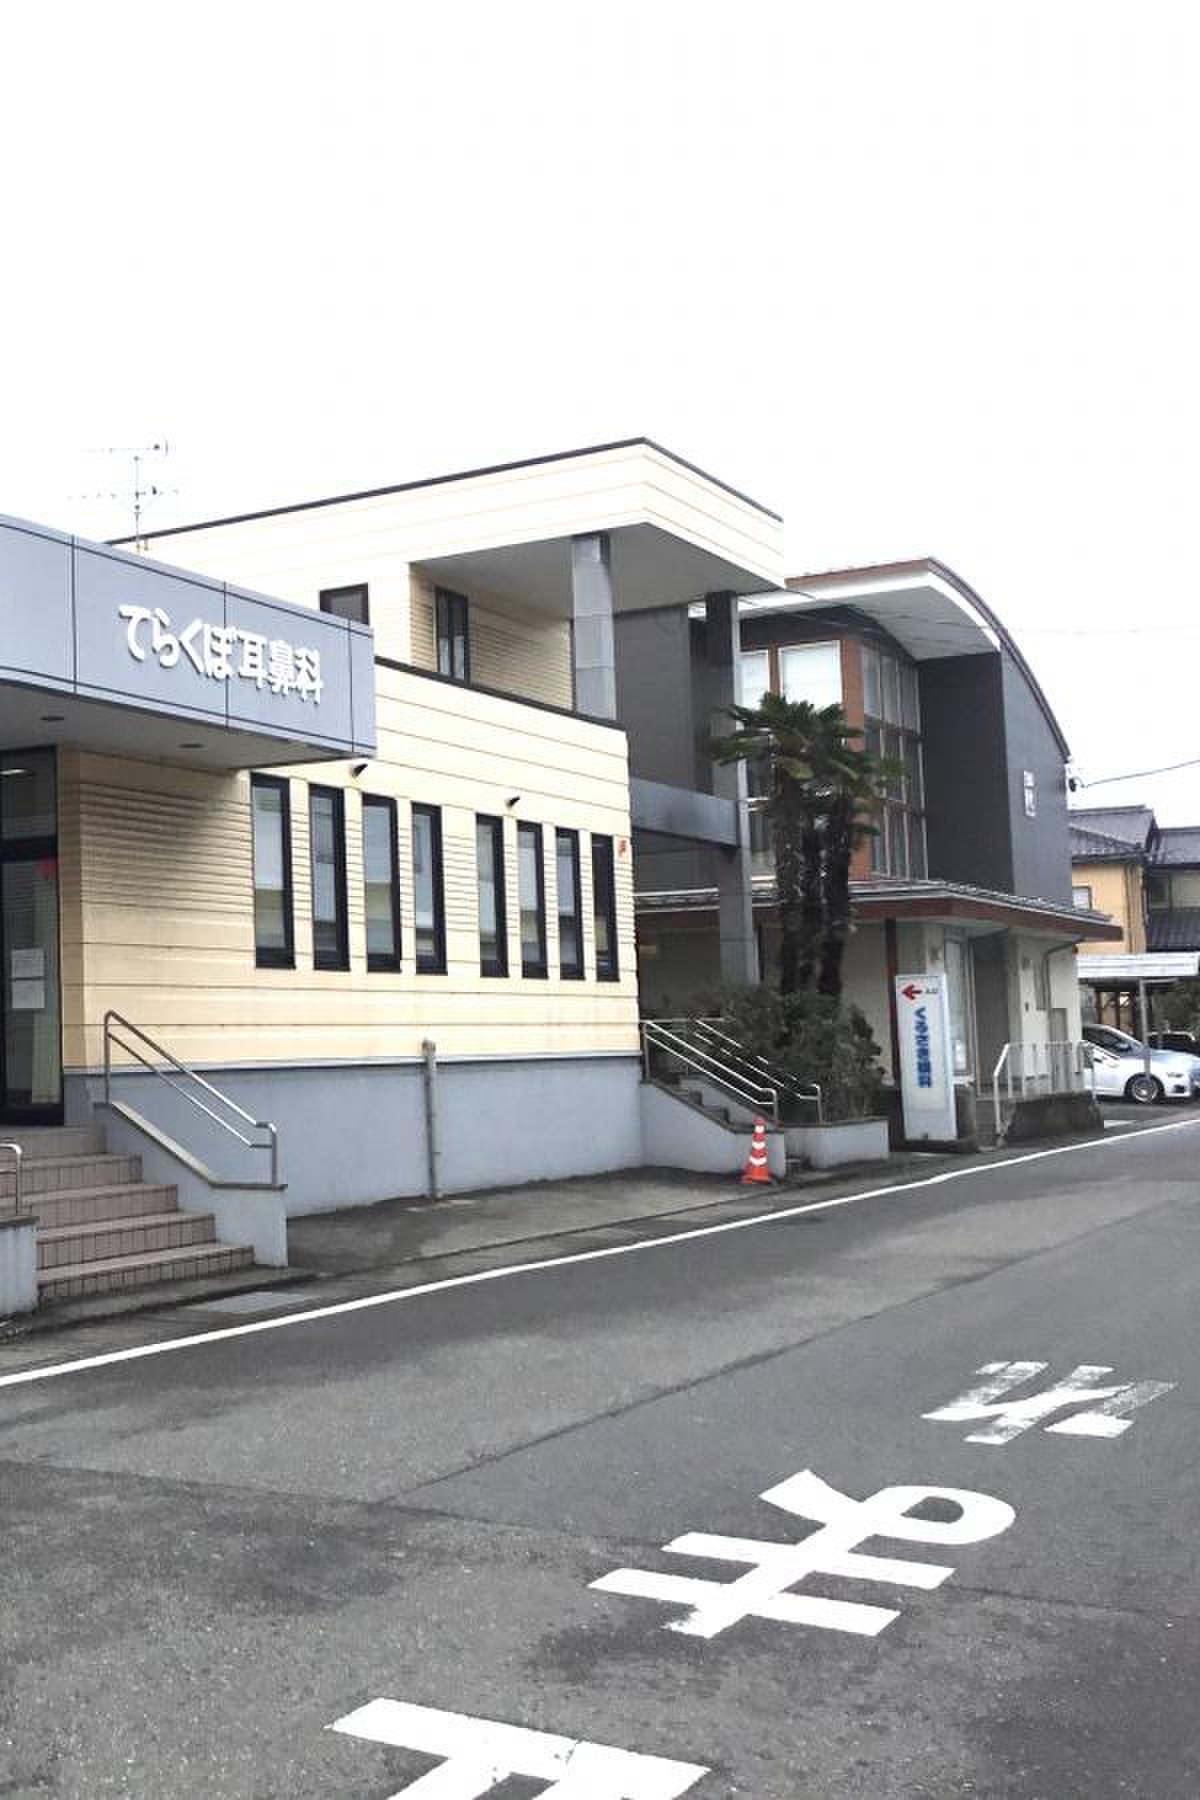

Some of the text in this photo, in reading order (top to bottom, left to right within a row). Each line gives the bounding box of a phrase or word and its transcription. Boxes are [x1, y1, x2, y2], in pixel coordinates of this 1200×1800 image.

[118, 604, 324, 704] てらくぼ耳鼻科
